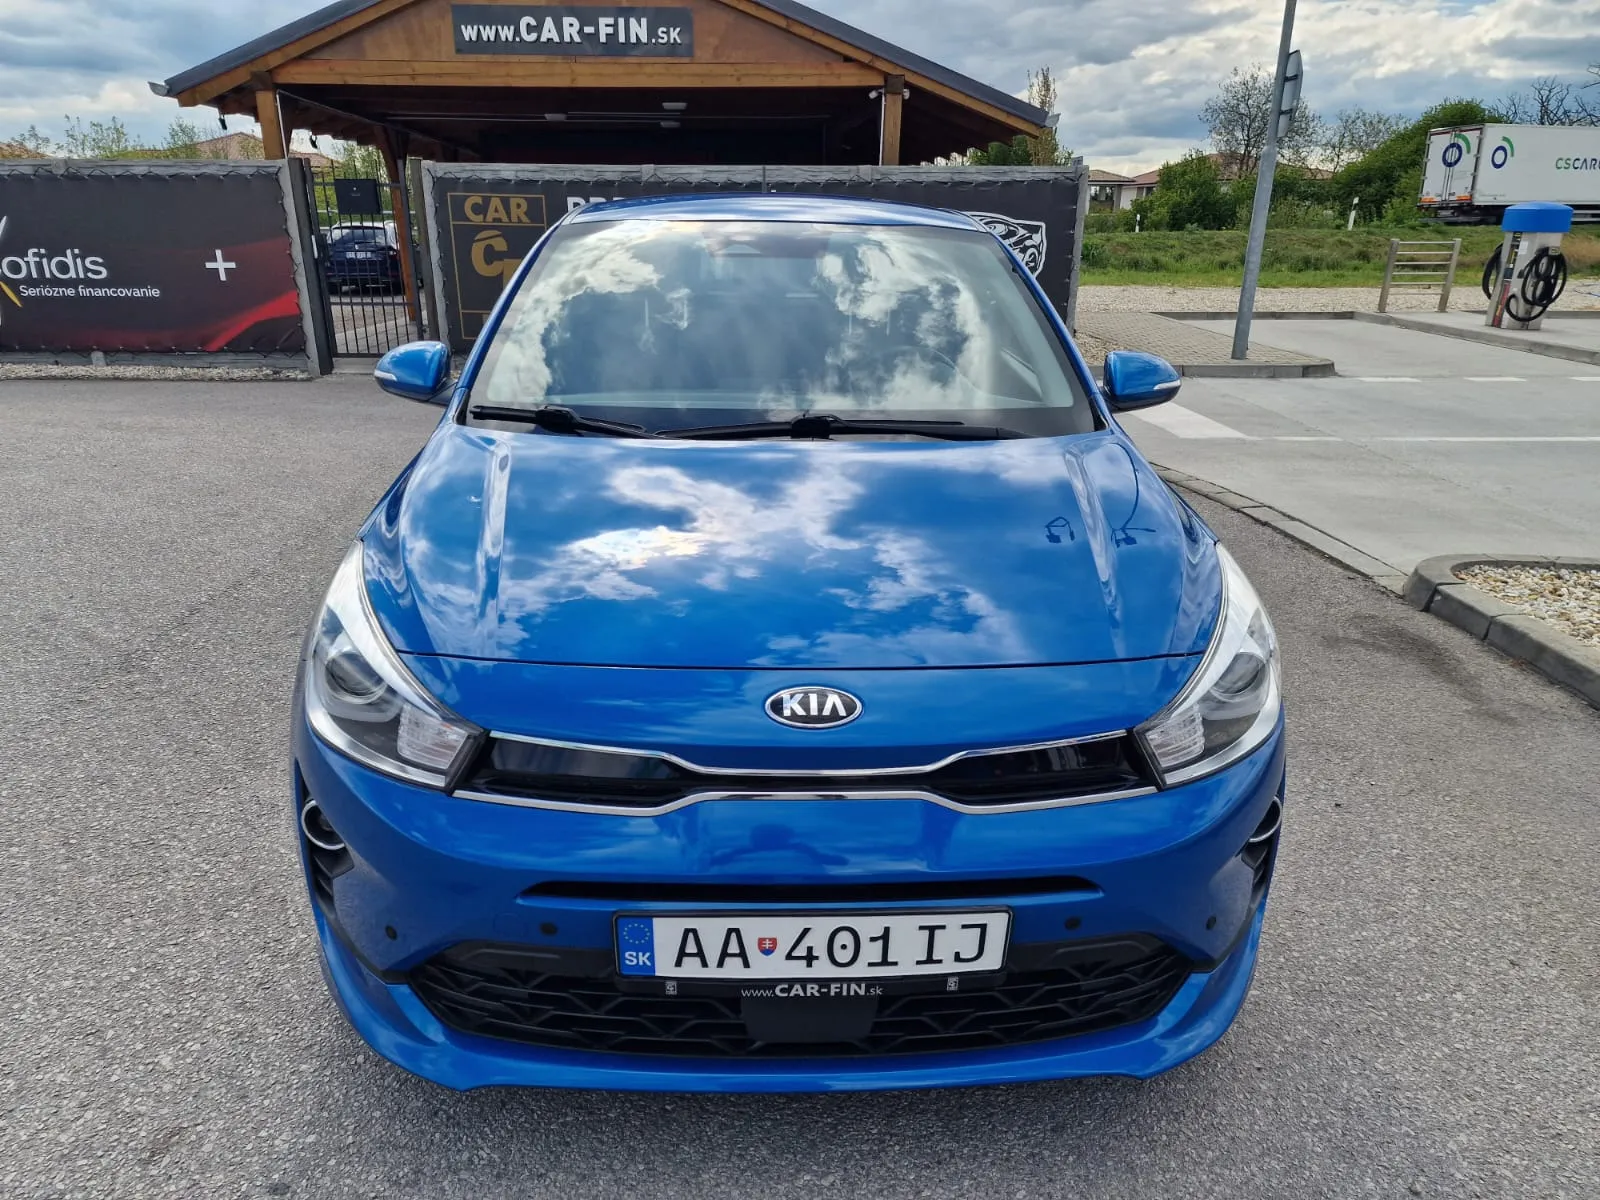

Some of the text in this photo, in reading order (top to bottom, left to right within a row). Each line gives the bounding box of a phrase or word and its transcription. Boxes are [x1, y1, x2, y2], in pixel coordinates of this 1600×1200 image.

[1555, 157, 1600, 170] CSCAR
[464, 195, 531, 223] CAR
[0, 248, 108, 280] ofidis
[19, 285, 161, 297] Seriózne financovanie
[781, 693, 847, 717] KIA
[674, 927, 751, 969] AA
[624, 951, 652, 966] SK
[741, 983, 884, 998] www.CAR-FIN.sk
